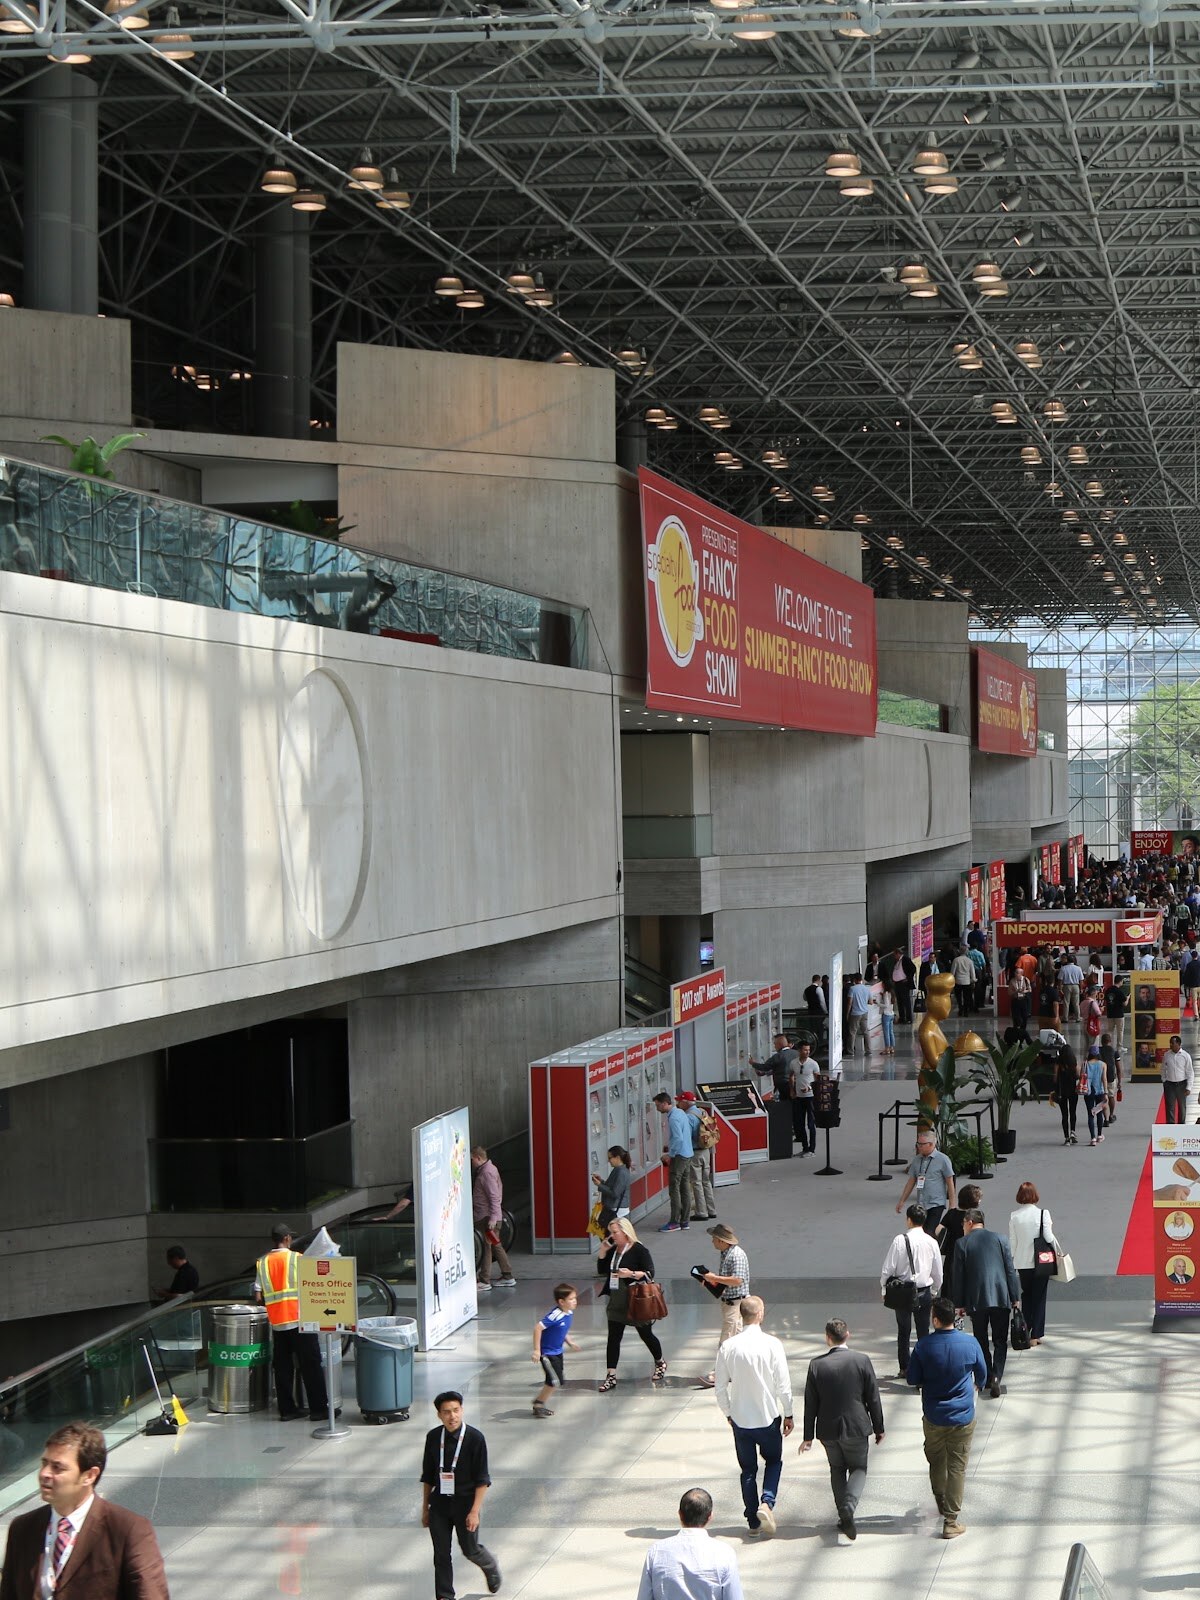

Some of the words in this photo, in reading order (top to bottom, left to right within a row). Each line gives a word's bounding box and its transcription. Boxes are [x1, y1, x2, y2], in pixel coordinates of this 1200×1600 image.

[702, 525, 727, 553] PRESENTS
[728, 536, 737, 557] THE
[702, 550, 737, 601] FANCY
[704, 597, 738, 651] FOOD
[774, 583, 822, 638] WELCOME
[824, 605, 836, 642] TO
[836, 610, 852, 648] THE
[706, 650, 738, 698] SHOW
[744, 626, 790, 676] SUMMER
[791, 640, 822, 684] FANCY
[824, 651, 848, 690] FOOD
[849, 658, 872, 696] SHOW
[1134, 839, 1168, 849] ENJOY
[1003, 923, 1105, 935] INFORMATION
[682, 990, 693, 1012] 2017
[706, 978, 724, 1001] Awards
[444, 1260, 466, 1288] REAL
[230, 1350, 266, 1360] RECYCLE
